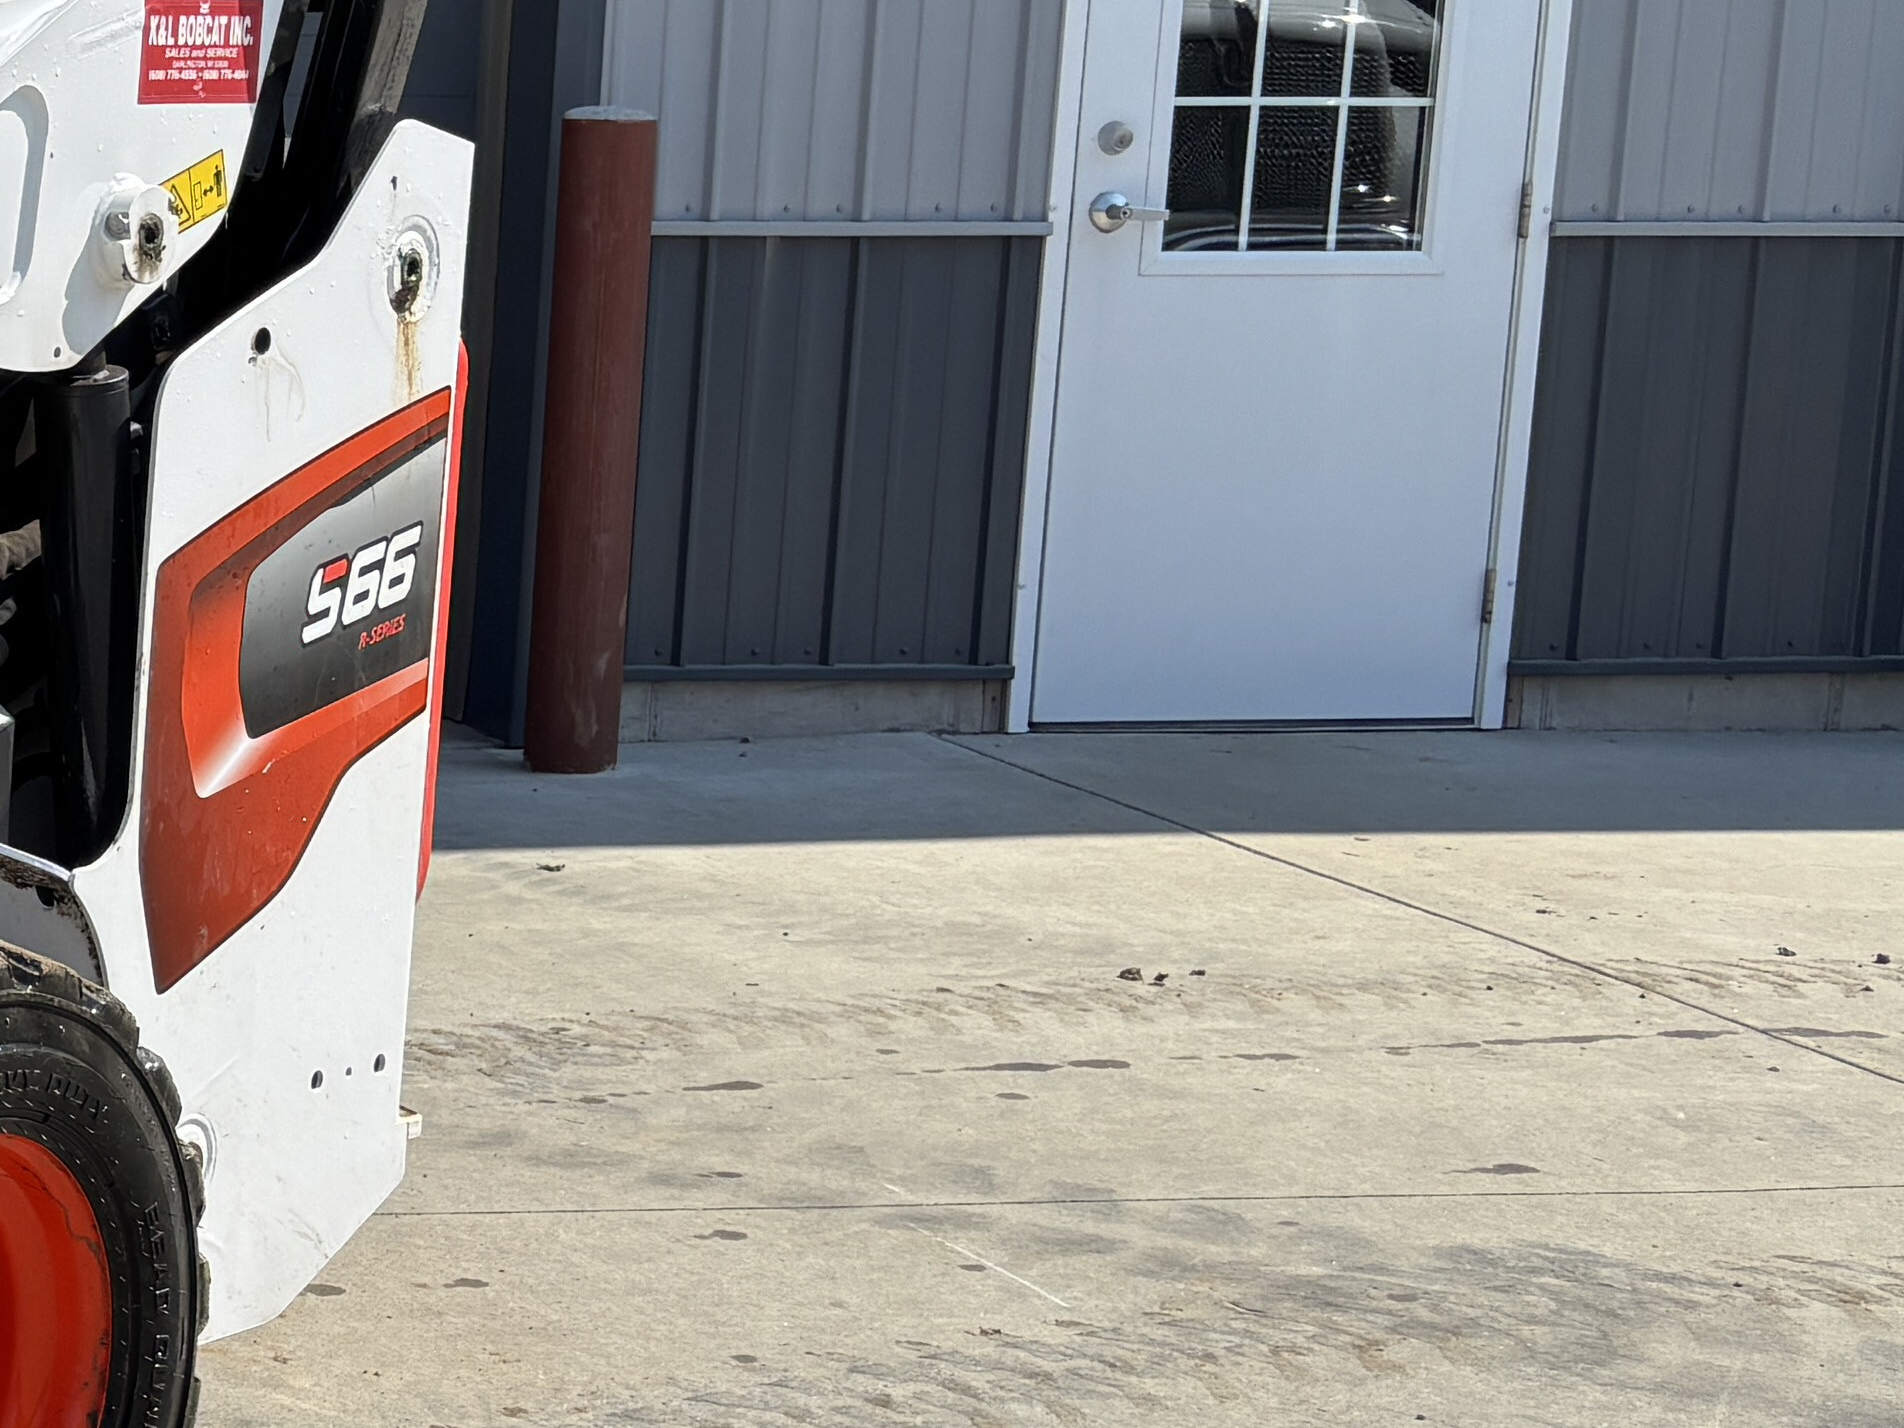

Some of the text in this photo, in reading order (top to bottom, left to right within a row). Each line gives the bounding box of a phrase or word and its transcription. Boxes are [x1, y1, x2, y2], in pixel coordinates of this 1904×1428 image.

[177, 15, 229, 46] BOBCAT
[229, 15, 253, 47] INC.
[165, 47, 191, 58] SALES
[206, 47, 239, 58] SERVICE
[301, 523, 423, 645] S66
[357, 612, 406, 651] R-SERIES
